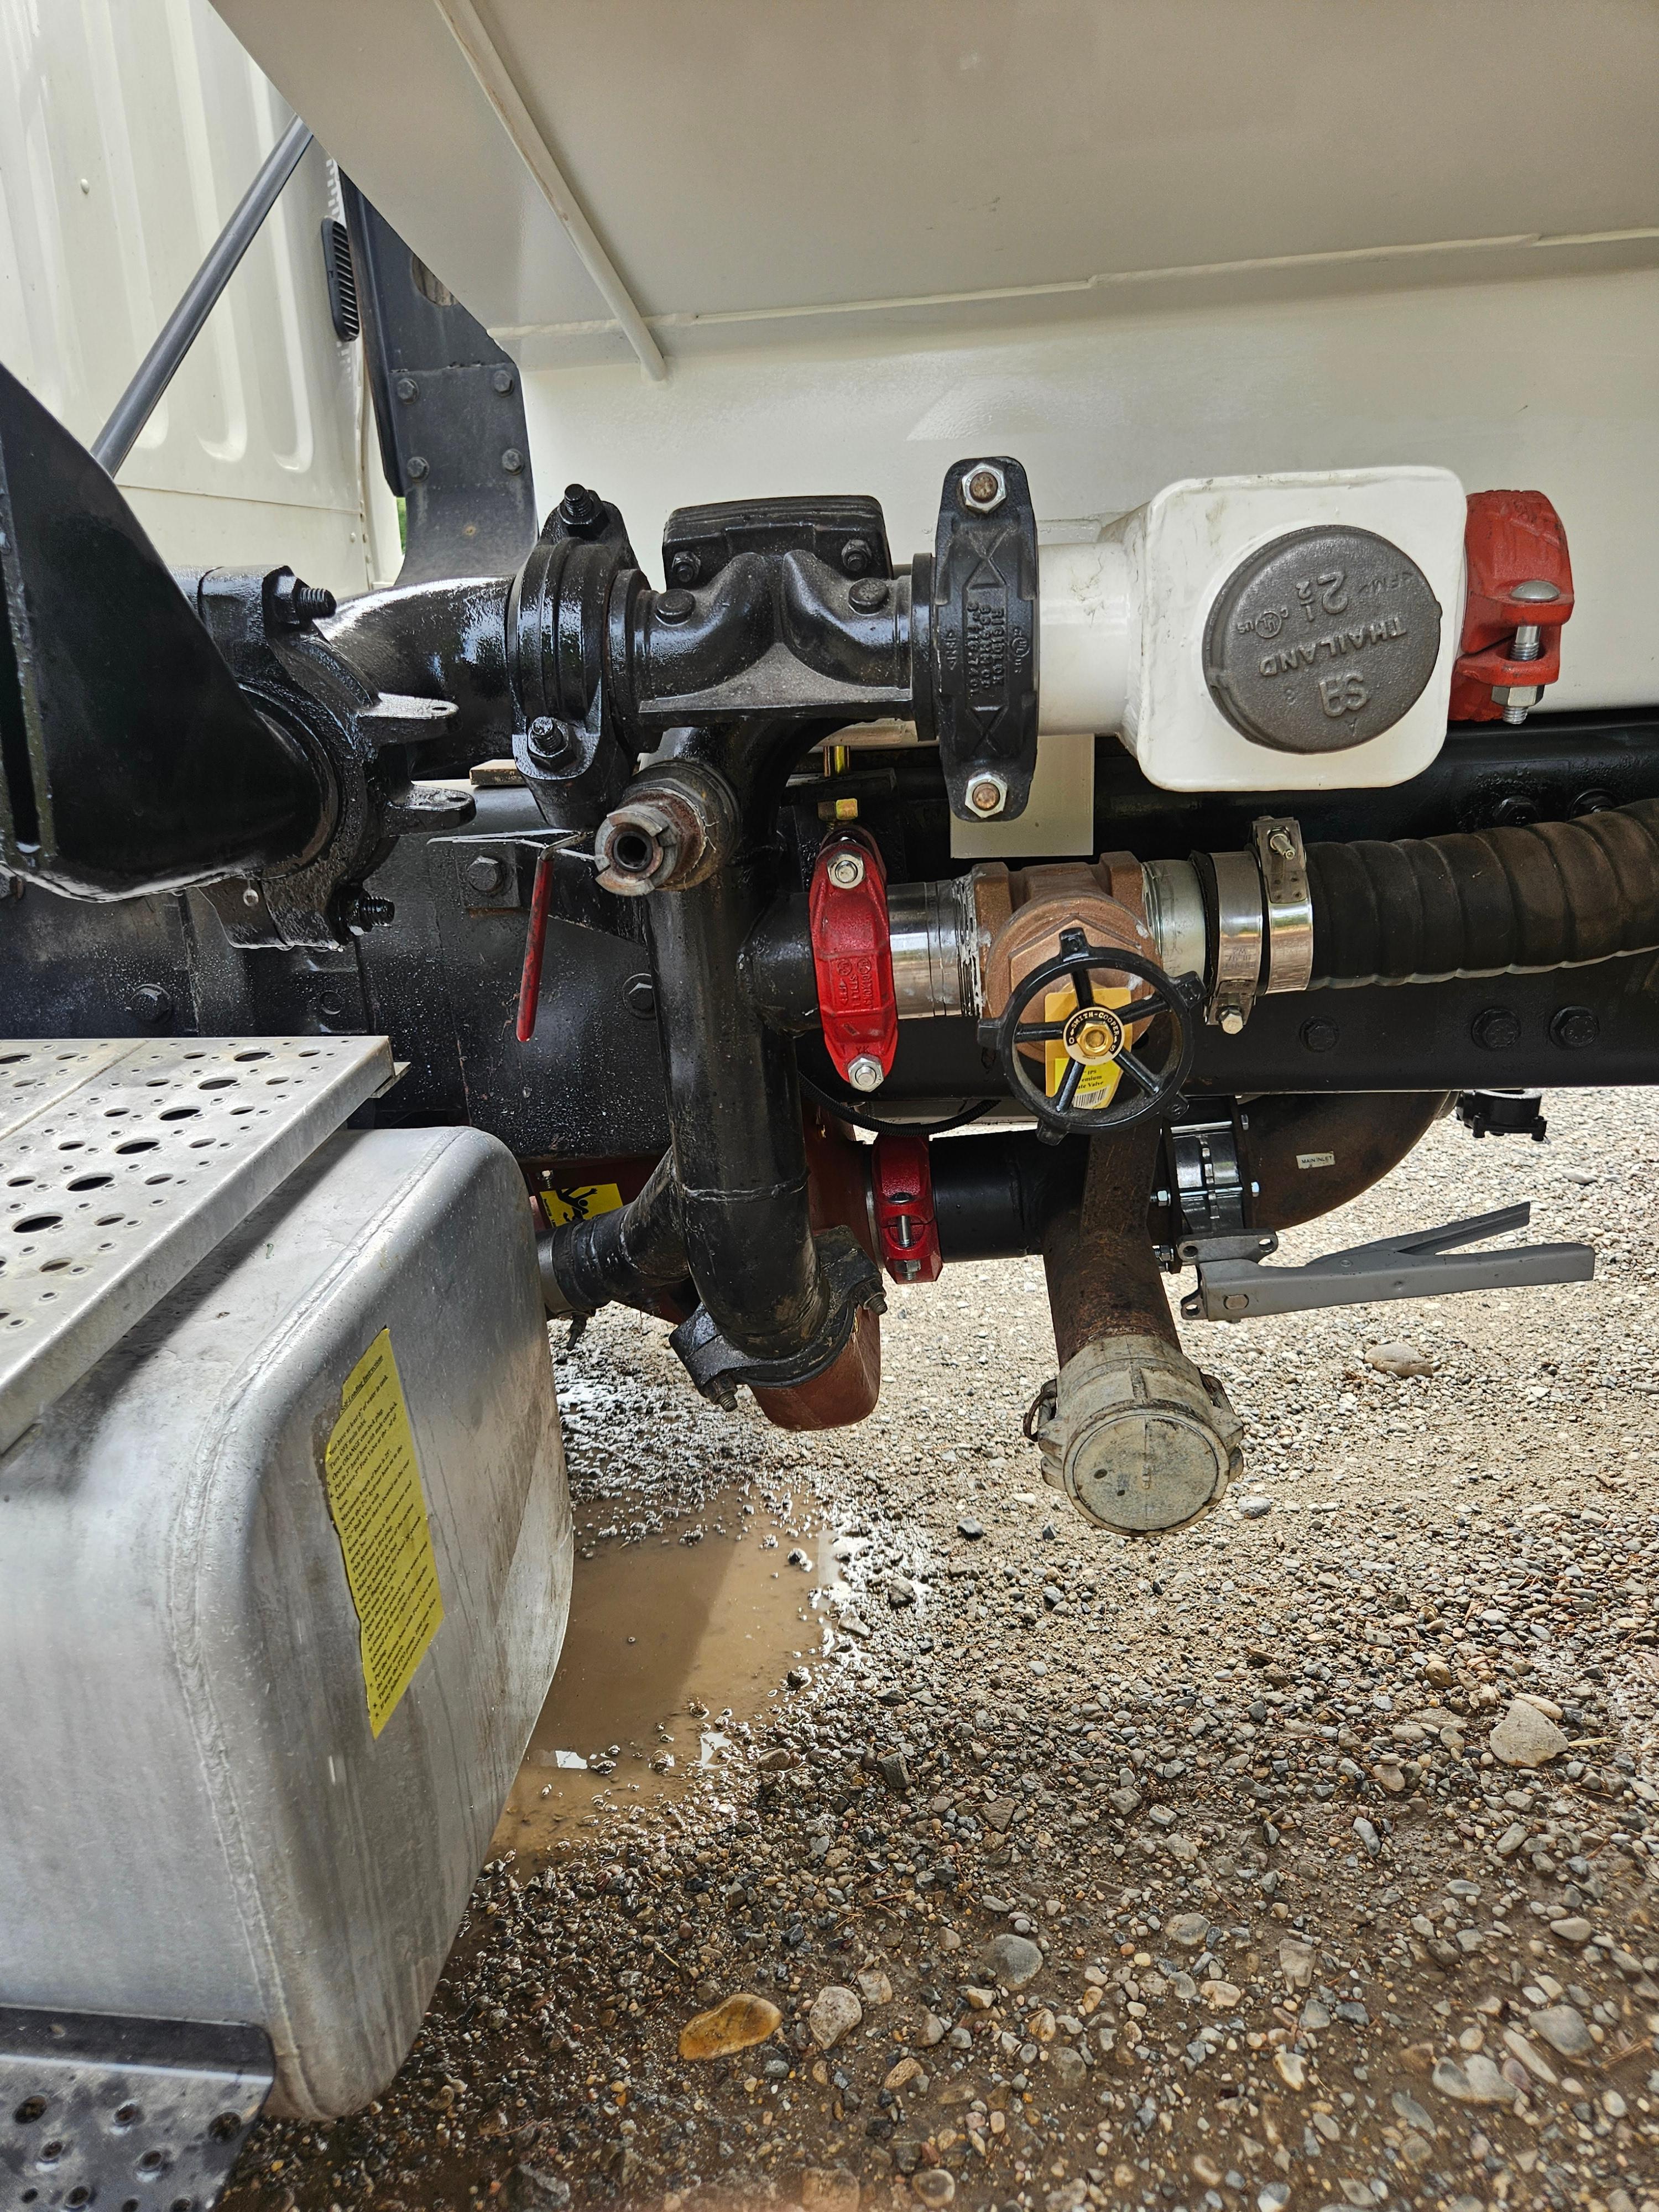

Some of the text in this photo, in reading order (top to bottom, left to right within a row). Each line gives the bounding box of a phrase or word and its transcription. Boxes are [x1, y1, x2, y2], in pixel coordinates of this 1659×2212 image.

[1259, 617, 1406, 676] THAILAND
[1071, 1011, 1119, 1036] SMITH-COOPER
[340, 1352, 383, 1416] Self-Loading Instructions
[337, 1430, 346, 1447] have
[349, 1412, 358, 1429] least
[366, 1387, 376, 1406] water
[330, 1452, 340, 1472] Turn
[348, 1427, 358, 1446] main
[332, 1463, 343, 1483] Open
[342, 1437, 361, 1468] ORANGE
[336, 1484, 347, 1504] Must
[346, 1472, 355, 1489] have
[359, 1453, 368, 1470] Foot
[367, 1439, 377, 1458] Valve
[351, 1452, 359, 1470] hard
[359, 1441, 367, 1457] hose
[367, 1430, 375, 1446] with
[341, 1493, 359, 1525] Maximum
[359, 1477, 370, 1498] length
[343, 1514, 354, 1535] Screw
[368, 1473, 382, 1498] hydrant
[381, 1462, 389, 1478] hose
[361, 1501, 372, 1522] Valve
[371, 1490, 379, 1507] with
[374, 1524, 382, 1542] hose
[367, 1548, 375, 1567] from
